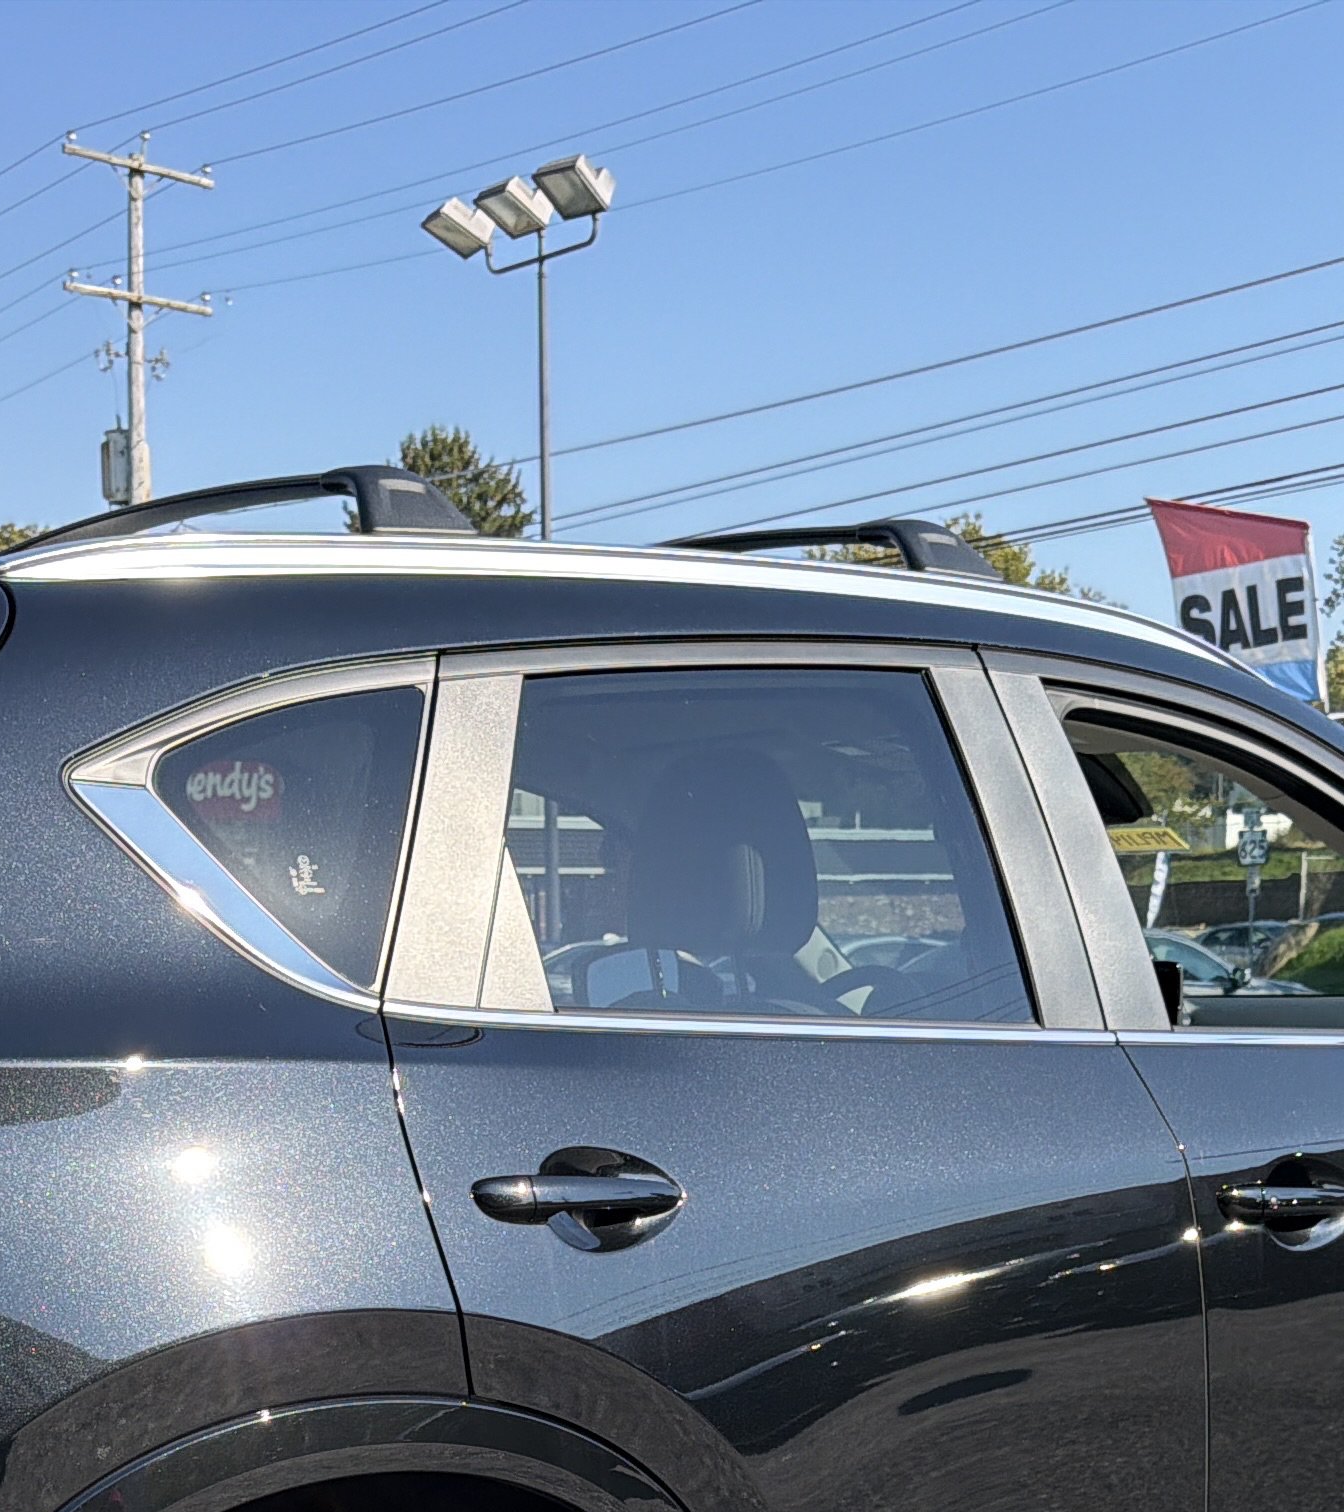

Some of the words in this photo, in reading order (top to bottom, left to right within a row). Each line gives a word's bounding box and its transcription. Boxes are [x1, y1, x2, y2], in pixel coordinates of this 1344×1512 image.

[1180, 576, 1308, 653] SALE
[186, 761, 275, 812] endy's
[1240, 839, 1267, 860] 625
